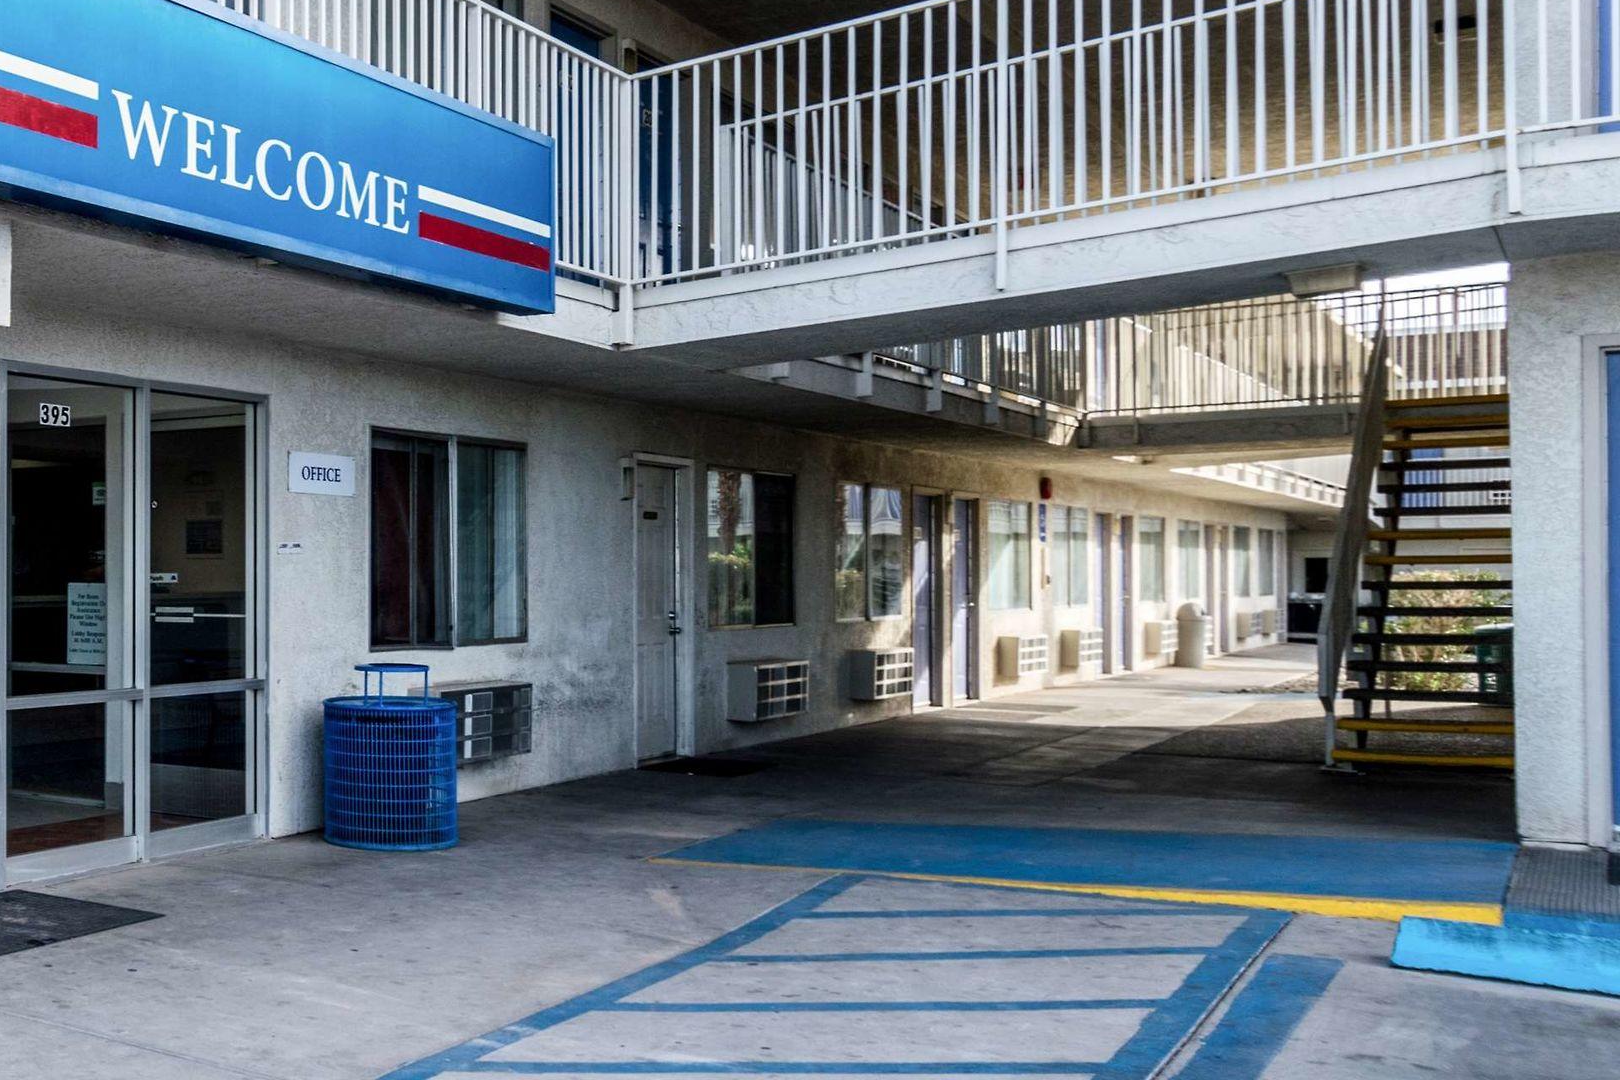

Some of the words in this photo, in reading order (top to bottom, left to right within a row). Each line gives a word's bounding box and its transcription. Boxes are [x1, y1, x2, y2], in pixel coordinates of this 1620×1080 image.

[111, 88, 410, 234] WELCOME
[41, 405, 69, 425] 395
[301, 465, 341, 482] OFFICE
